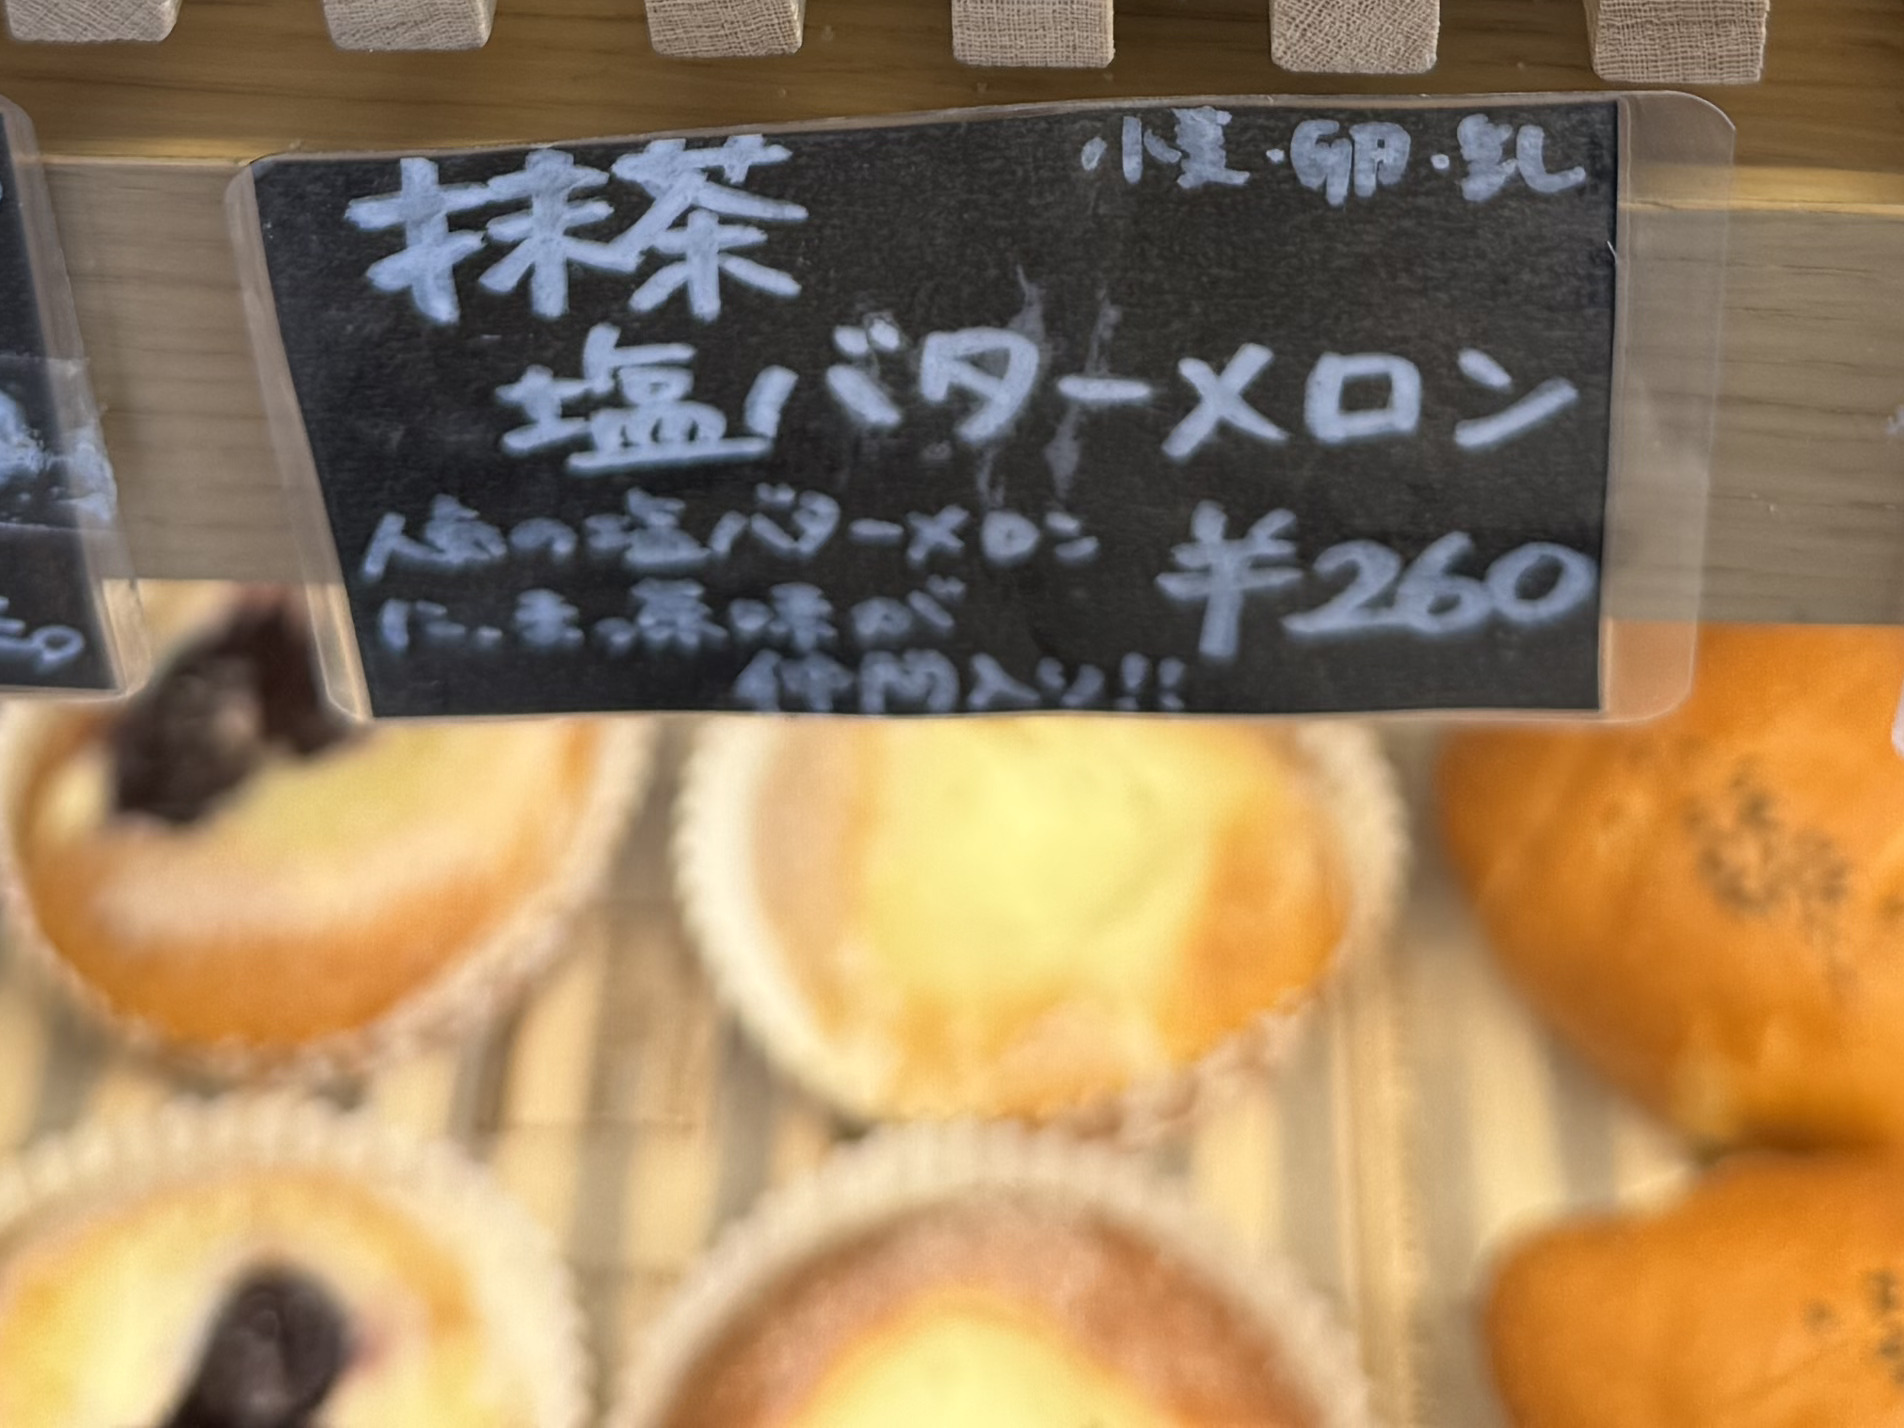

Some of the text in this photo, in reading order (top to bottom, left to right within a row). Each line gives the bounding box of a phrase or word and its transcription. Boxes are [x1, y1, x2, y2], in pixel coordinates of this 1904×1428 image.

[344, 134, 809, 325] 抹茶
[495, 310, 1580, 474] 塩バターメロン
[1153, 499, 1600, 663] ¥260
